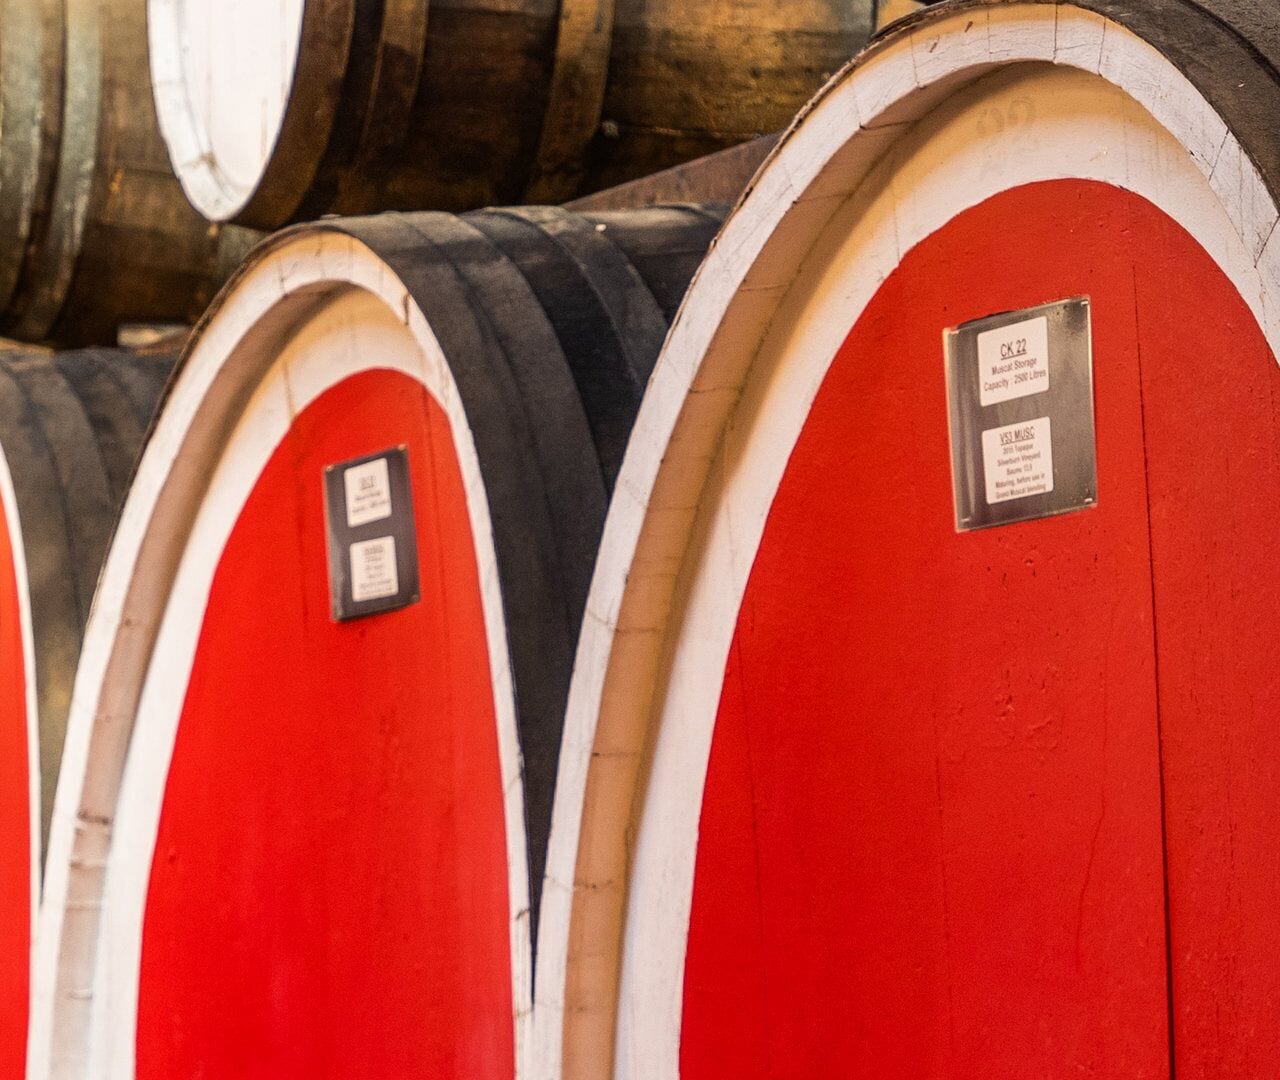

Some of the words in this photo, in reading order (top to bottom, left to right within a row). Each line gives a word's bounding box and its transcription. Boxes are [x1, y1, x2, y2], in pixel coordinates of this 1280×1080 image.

[1001, 342, 1014, 358] CK
[1016, 338, 1027, 353] 22
[1014, 358, 1037, 369] Storage
[984, 378, 1008, 391] Capacity
